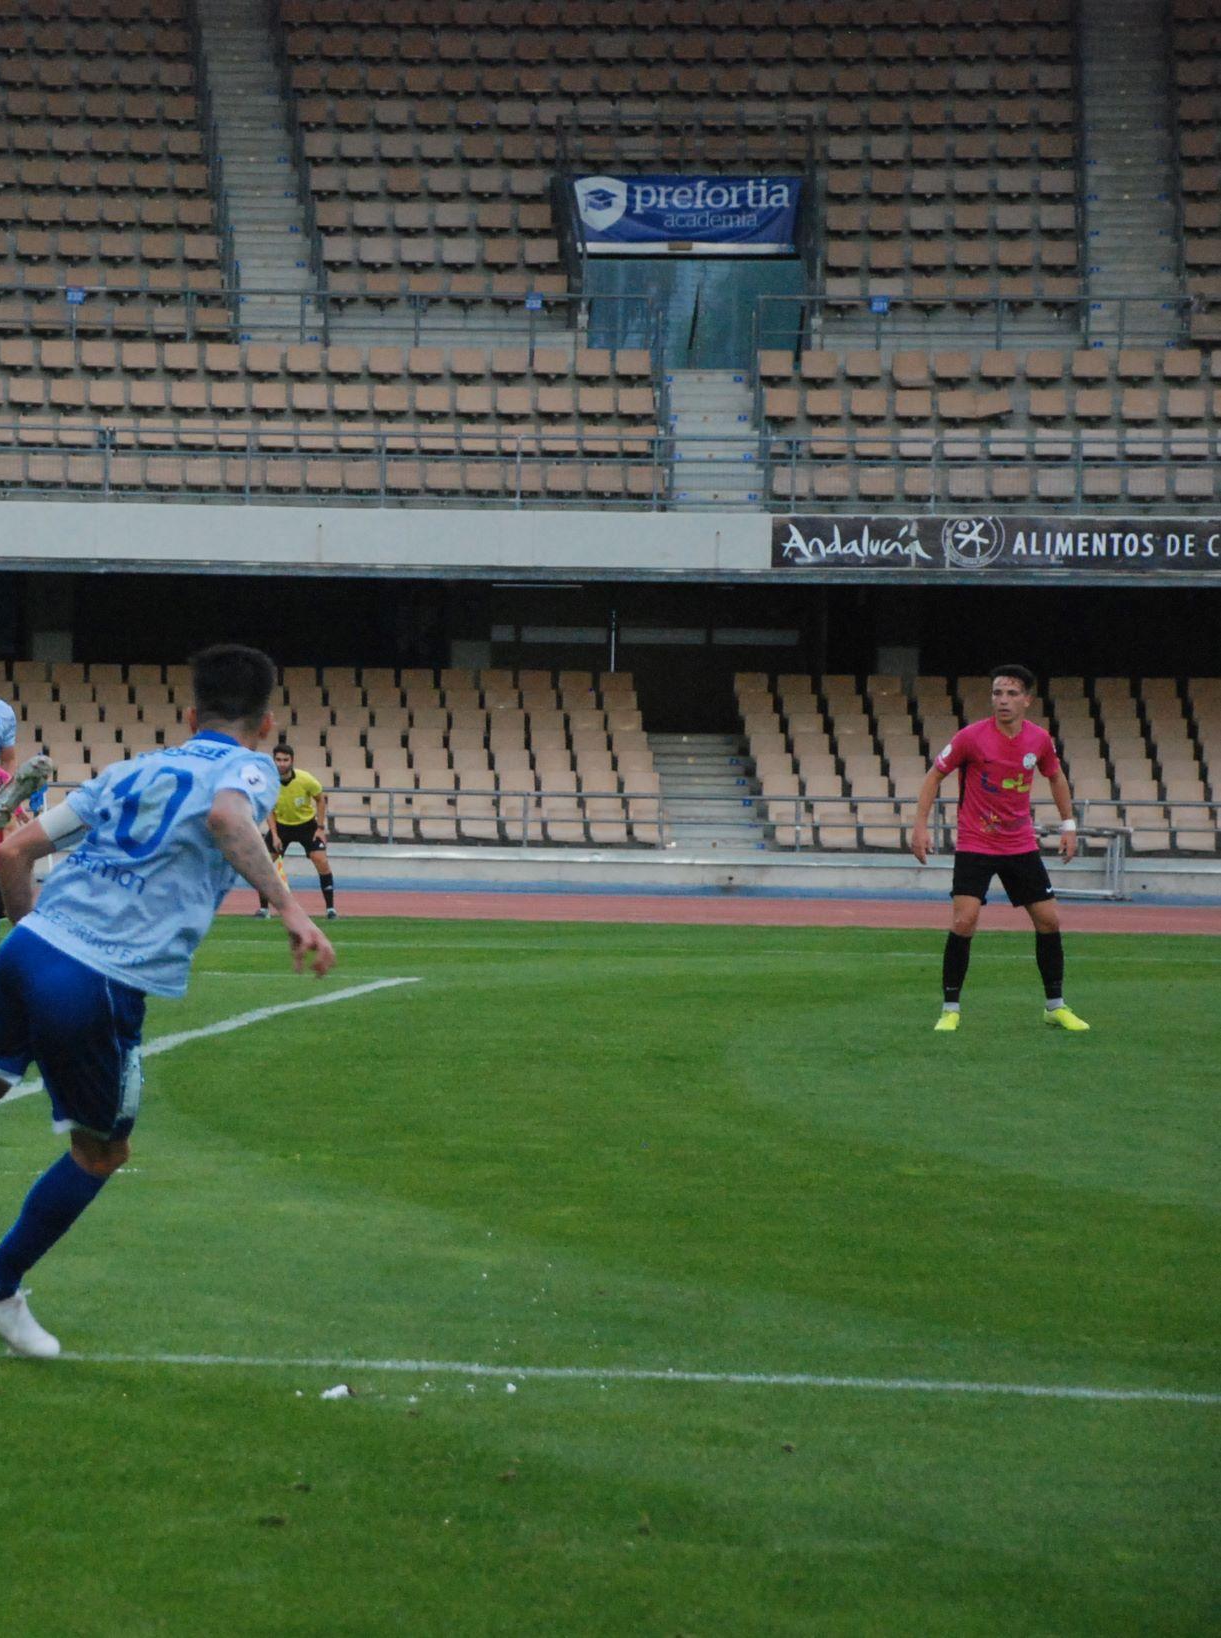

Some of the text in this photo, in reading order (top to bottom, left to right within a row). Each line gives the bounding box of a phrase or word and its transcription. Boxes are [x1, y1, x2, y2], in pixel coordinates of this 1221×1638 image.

[632, 178, 790, 214] prefortia
[663, 211, 759, 228] academia
[781, 523, 933, 560] Andalucía
[1012, 531, 1154, 557] ALIMENTOS
[1166, 533, 1195, 557] DE
